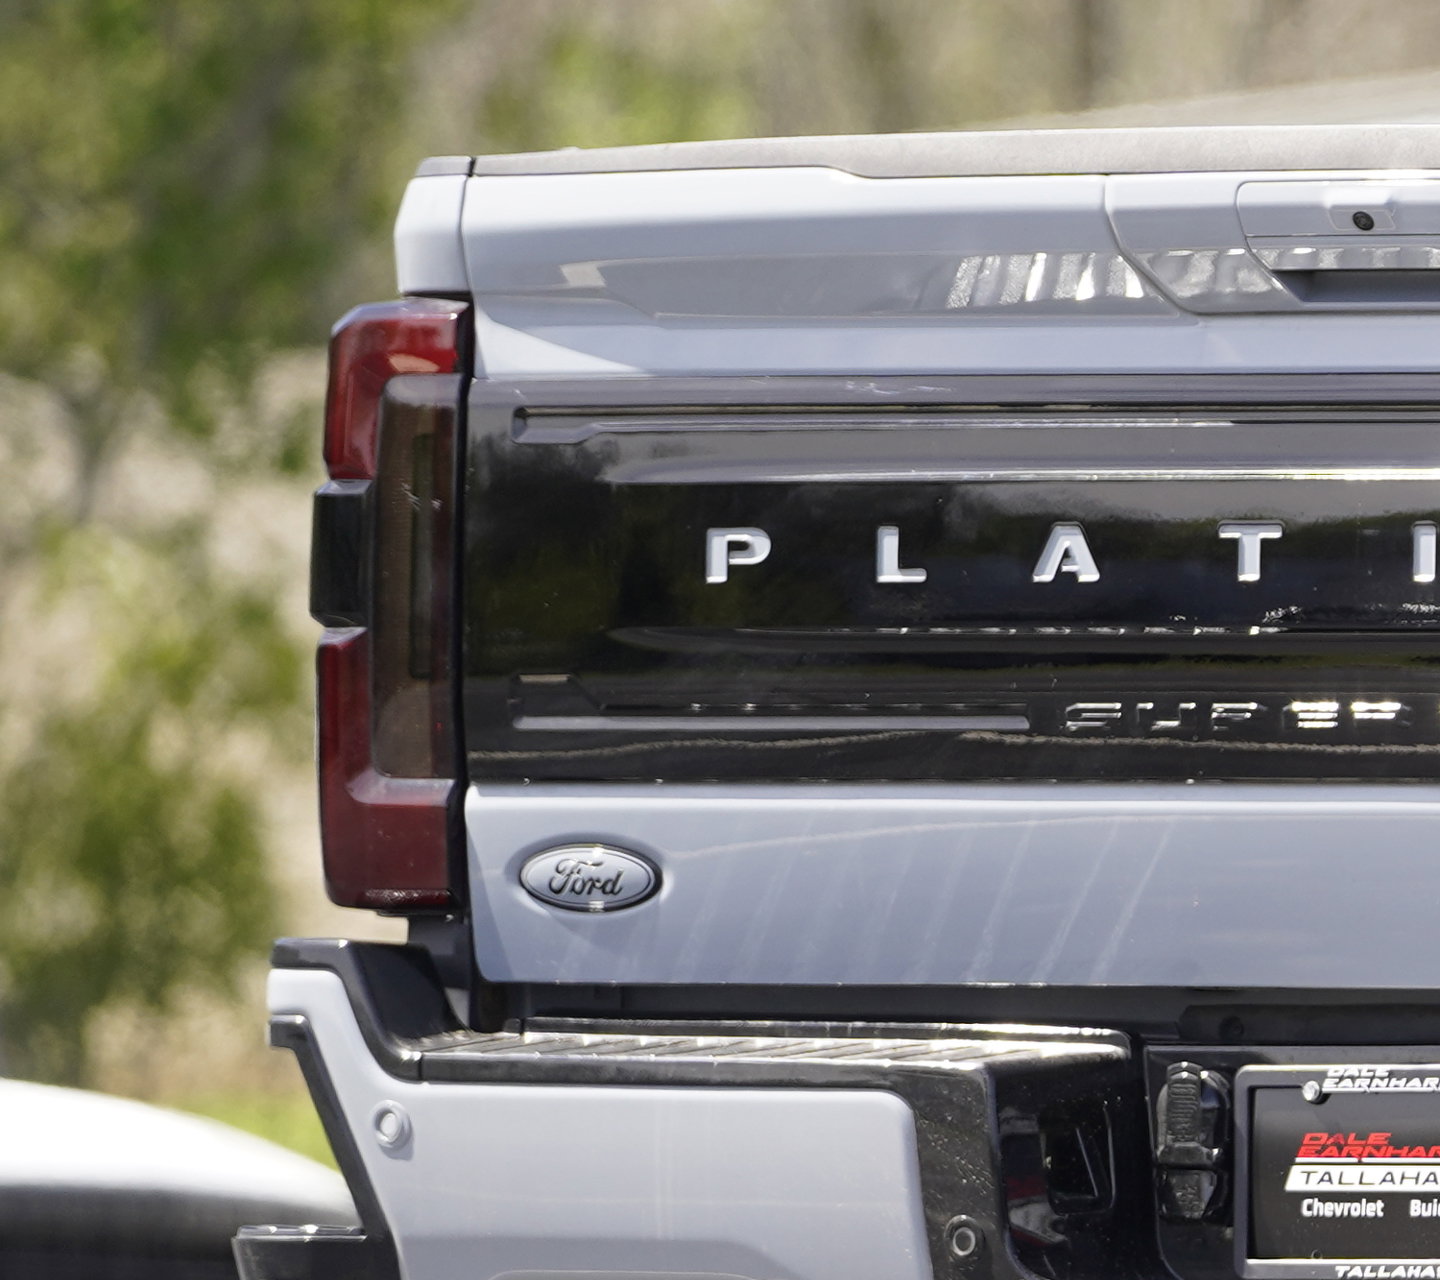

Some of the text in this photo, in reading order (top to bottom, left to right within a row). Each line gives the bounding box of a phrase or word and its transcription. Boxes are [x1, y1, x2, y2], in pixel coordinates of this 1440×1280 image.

[549, 859, 624, 896] Ford
[1327, 1067, 1391, 1078] DALE
[1302, 1132, 1392, 1145] DALE
[1301, 1197, 1385, 1218] Chevrolet
